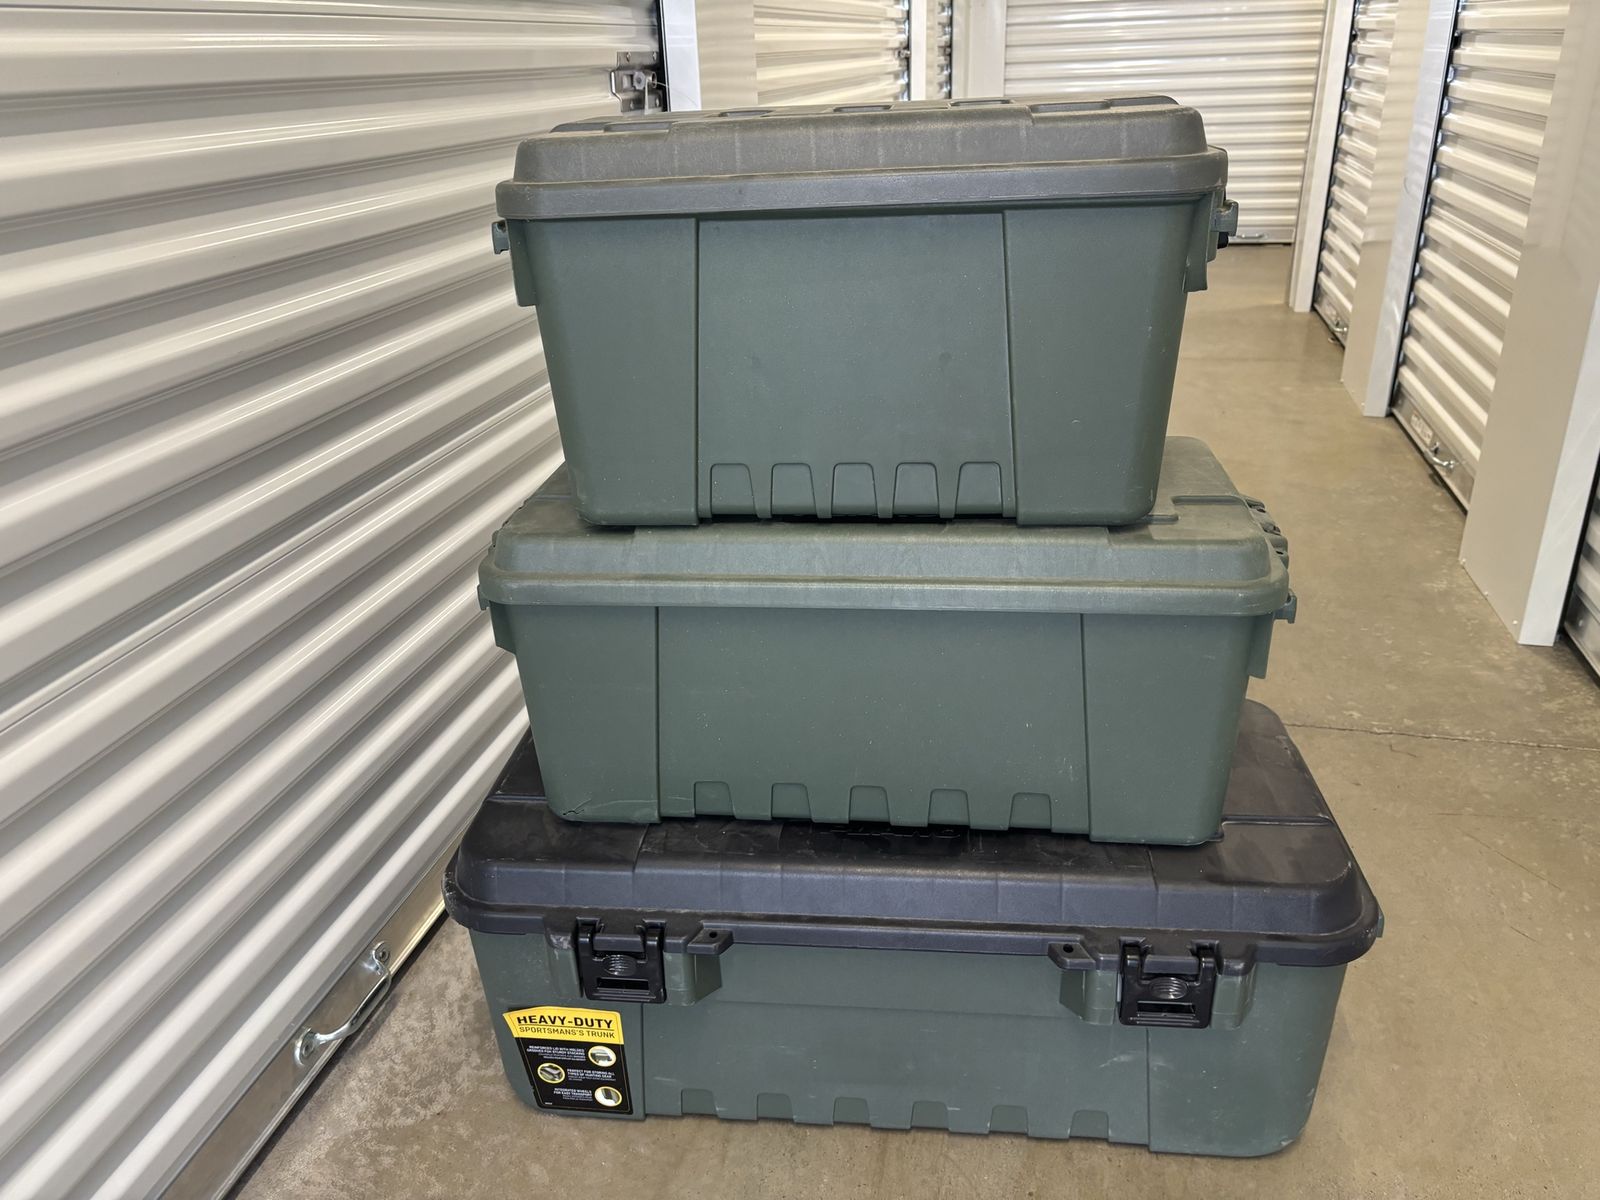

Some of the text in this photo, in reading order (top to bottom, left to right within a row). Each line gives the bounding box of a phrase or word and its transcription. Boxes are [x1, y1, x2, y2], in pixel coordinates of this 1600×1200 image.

[517, 1015, 612, 1028] HEAVY-DUTY
[520, 1027, 615, 1038] SPORTSMANS'S TRUNK
